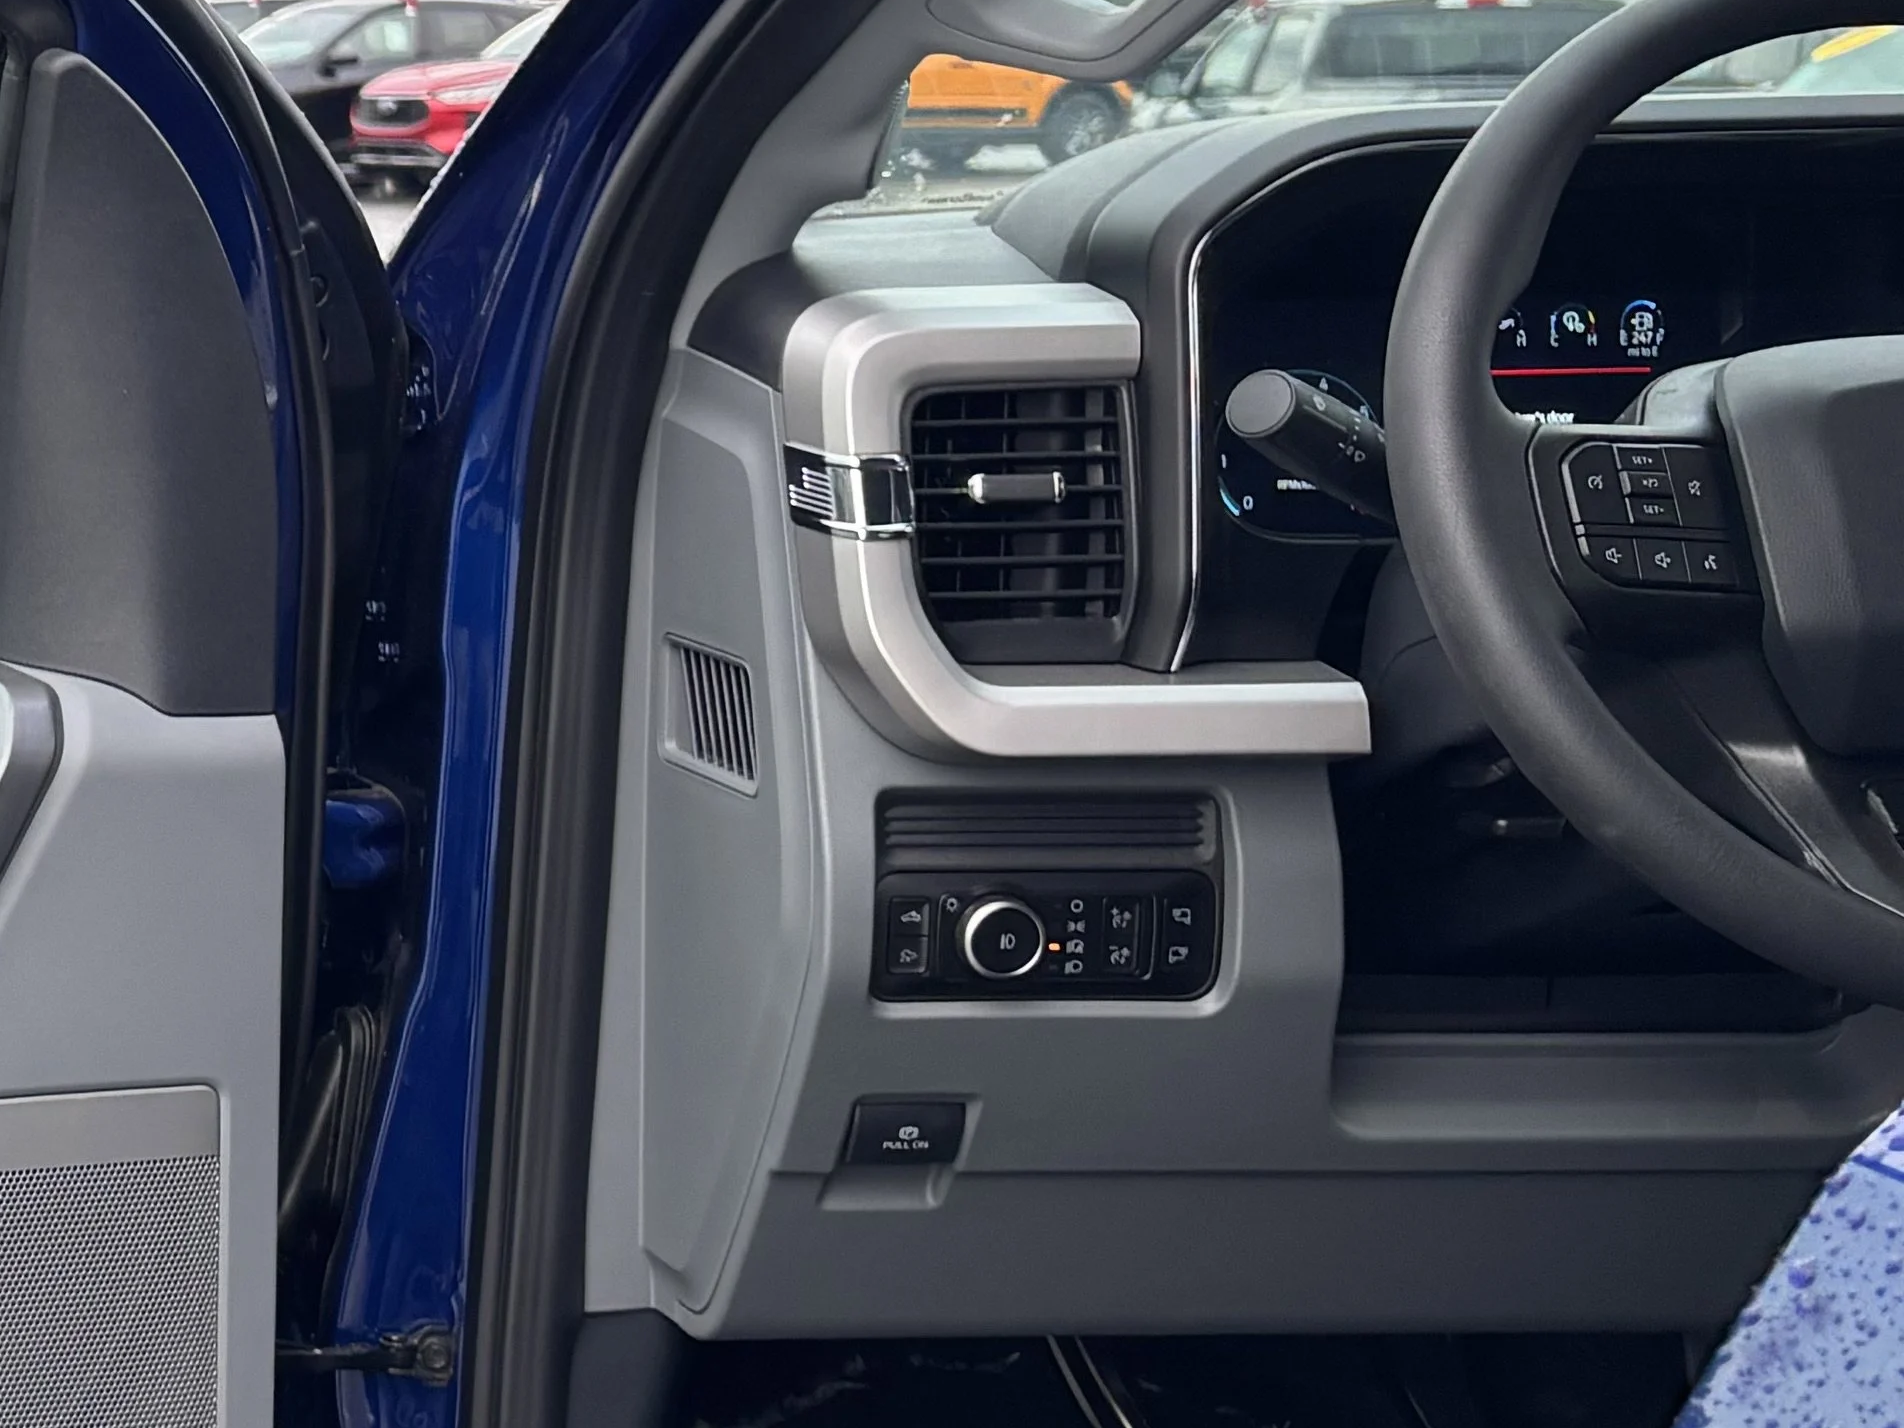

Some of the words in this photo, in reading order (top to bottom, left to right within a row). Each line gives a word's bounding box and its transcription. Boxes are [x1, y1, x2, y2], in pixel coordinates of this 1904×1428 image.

[1632, 331, 1653, 345] 247
[1243, 495, 1254, 510] 0
[912, 1140, 929, 1149] ON
